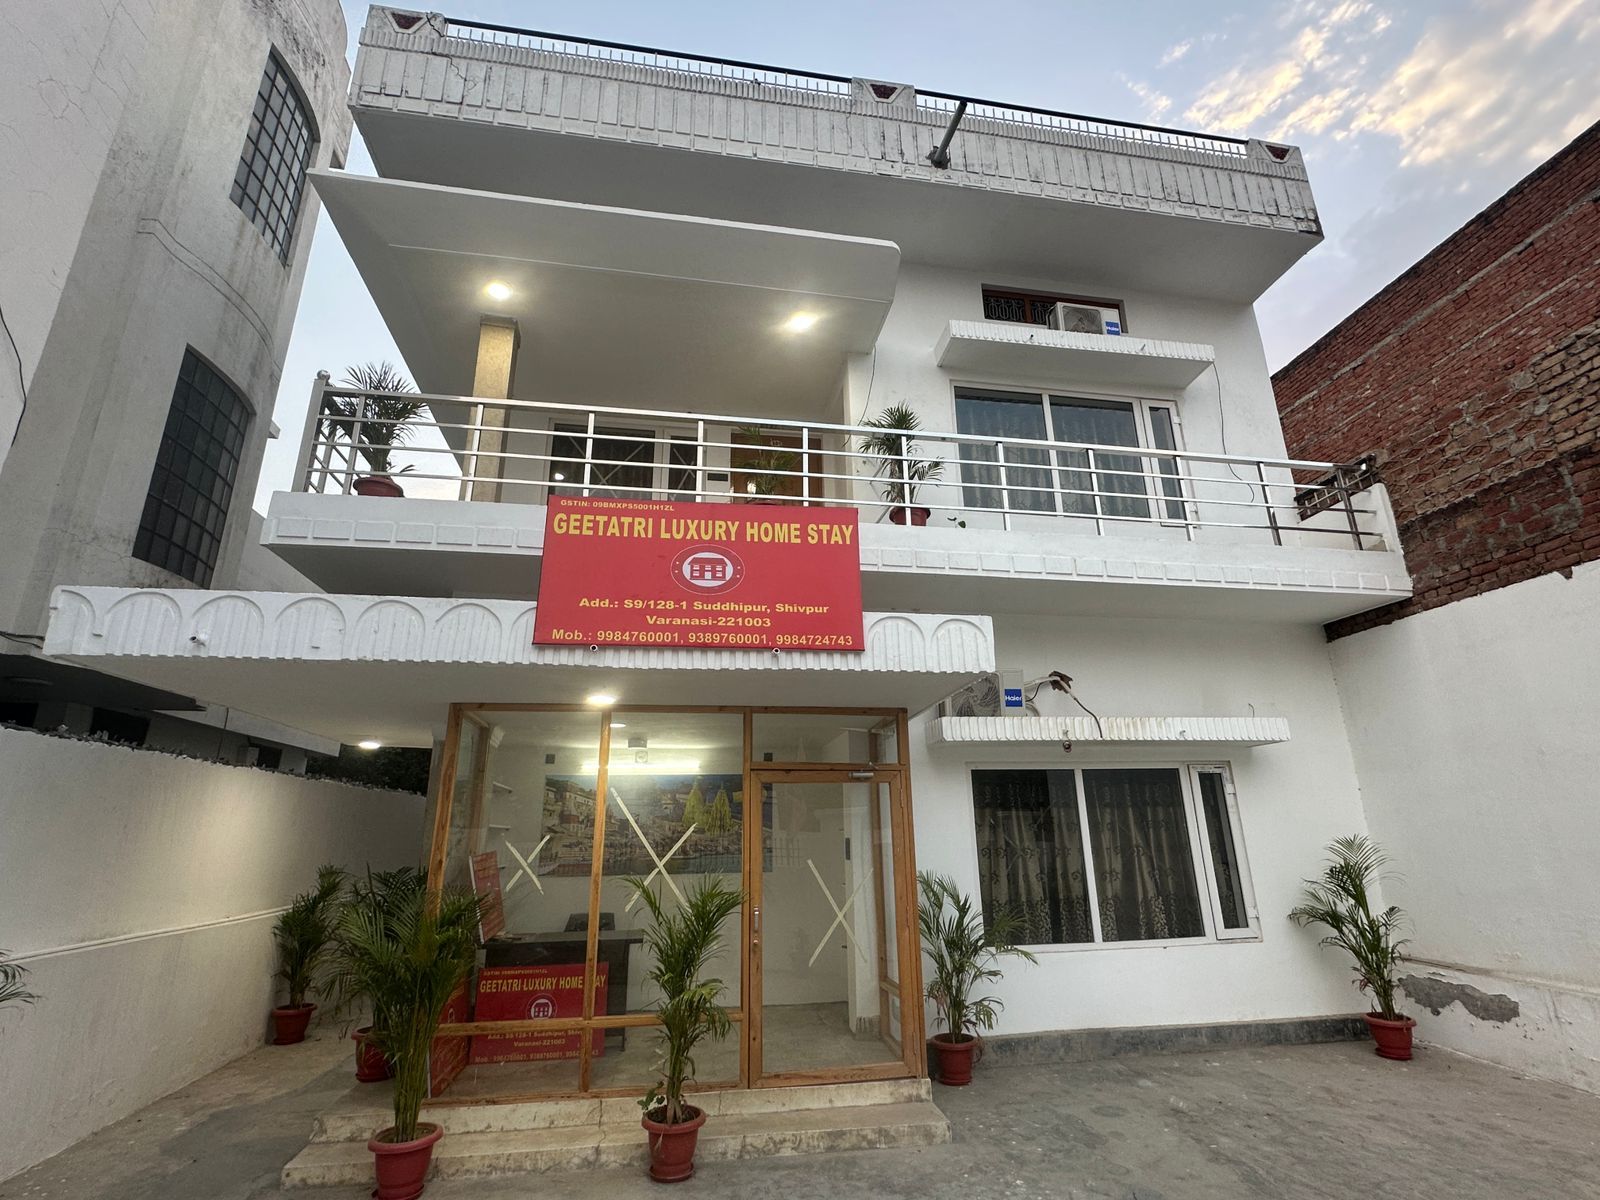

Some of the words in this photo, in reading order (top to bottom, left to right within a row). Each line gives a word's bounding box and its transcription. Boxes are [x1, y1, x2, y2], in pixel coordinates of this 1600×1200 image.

[560, 499, 590, 508] GSTIN:
[553, 512, 653, 538] GEETATRI
[660, 518, 740, 542] LUXURY
[746, 521, 801, 544] HOME
[807, 523, 854, 545] STAY
[579, 598, 619, 608] Add.:
[623, 599, 687, 610] S9/128-1
[692, 601, 771, 614] Suddhipur,
[775, 603, 830, 615] Shivpur
[645, 615, 772, 627] Varanasi-221003
[551, 629, 592, 641] Mob.:
[596, 630, 684, 644] 9984760001,
[688, 631, 772, 646] 9389760001,
[776, 634, 853, 646] 9984724743
[480, 979, 521, 993] GEETATRI
[523, 977, 558, 991] LUXURY
[559, 976, 584, 989] HOME
